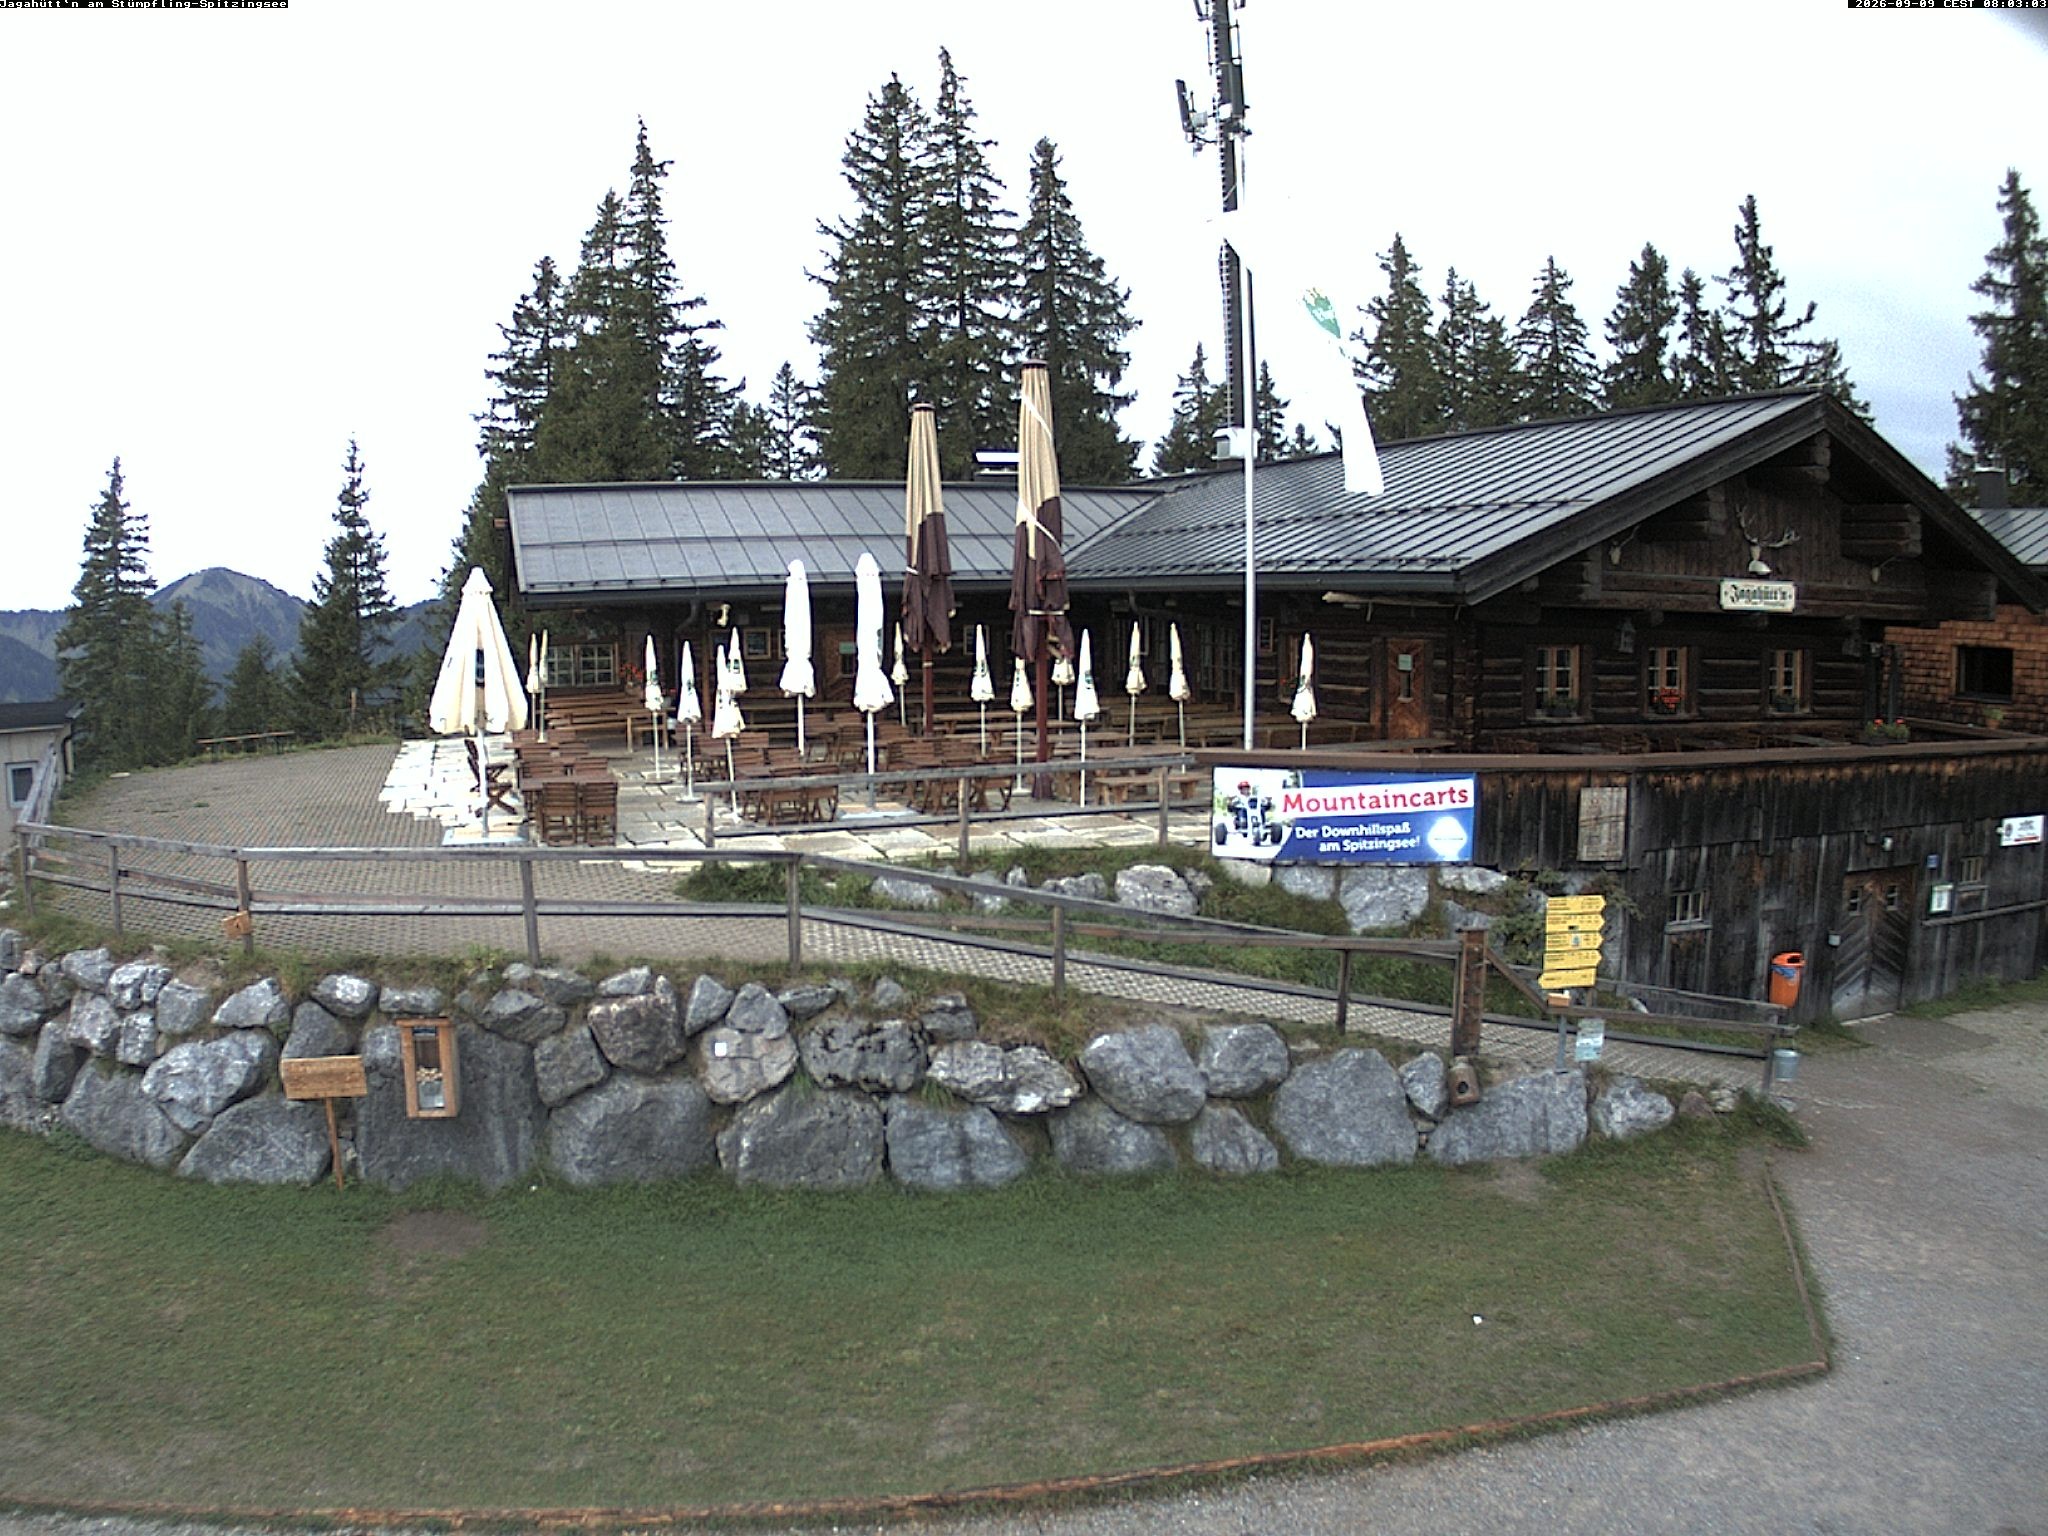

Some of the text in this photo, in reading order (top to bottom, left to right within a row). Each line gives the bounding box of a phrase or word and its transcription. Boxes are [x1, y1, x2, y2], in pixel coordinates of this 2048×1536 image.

[1282, 786, 1470, 813] Mountaincarts
[1295, 821, 1411, 839] Der Downhillspaß
[1319, 841, 1341, 852] am
